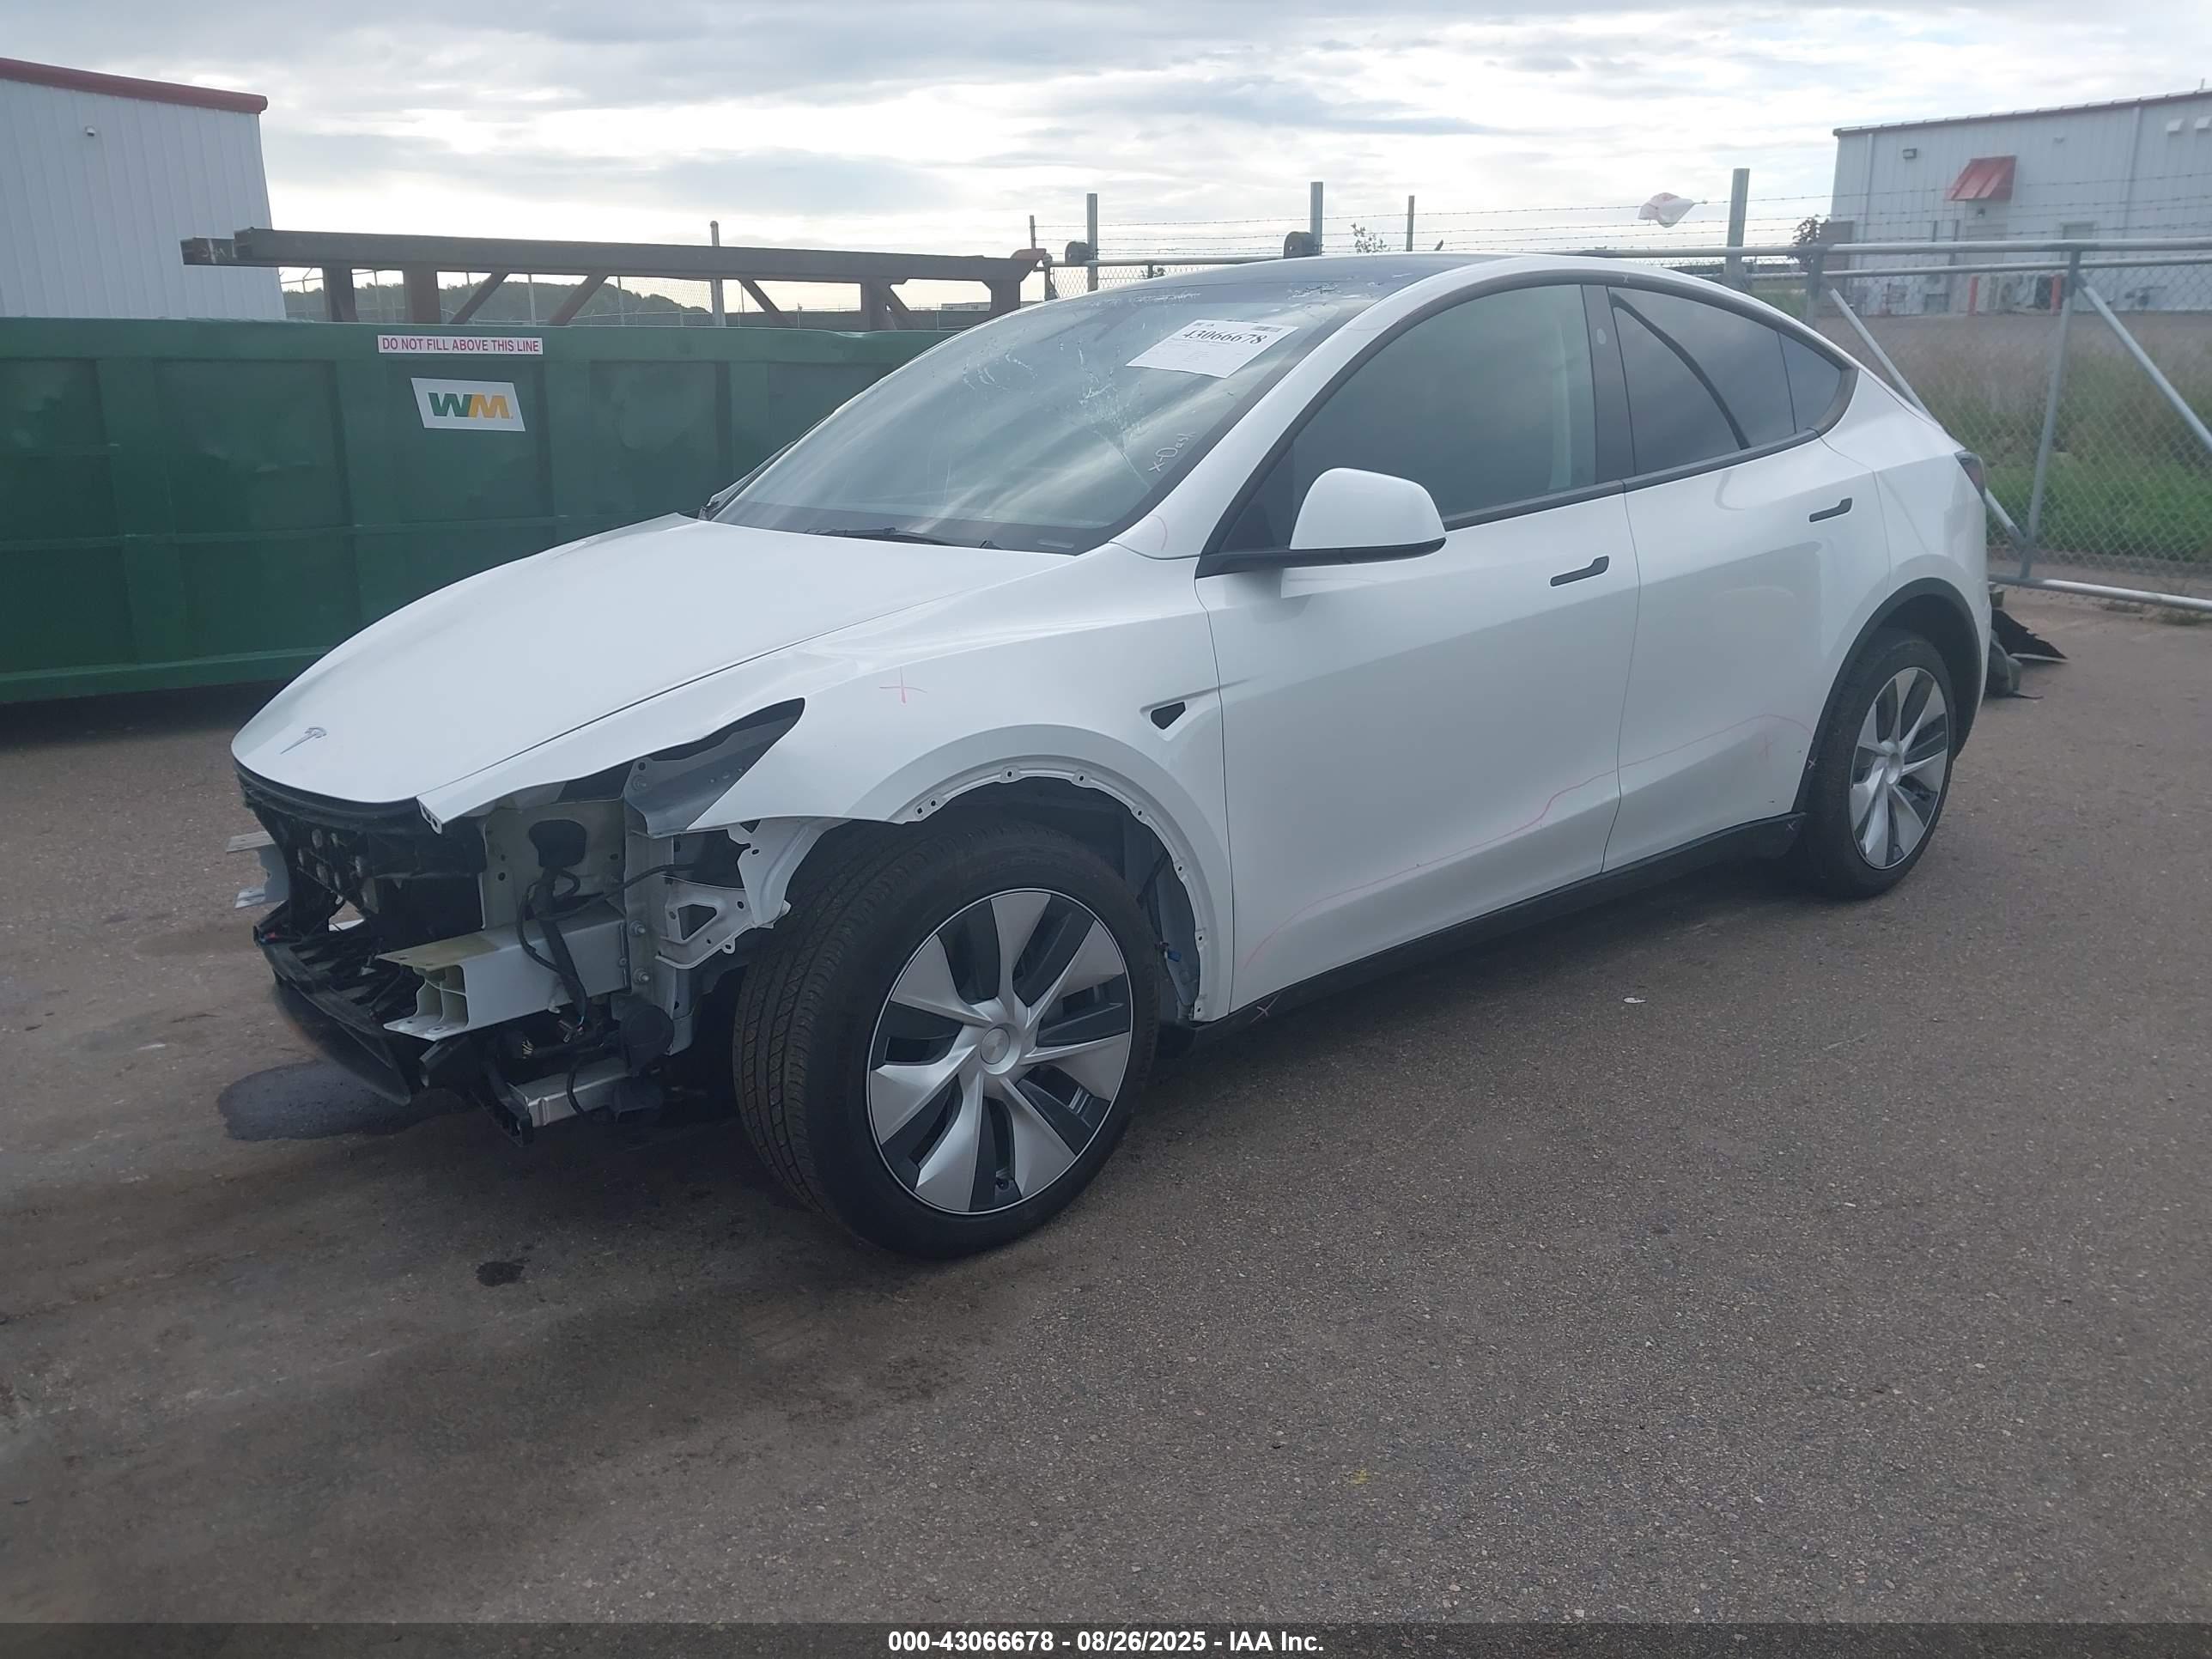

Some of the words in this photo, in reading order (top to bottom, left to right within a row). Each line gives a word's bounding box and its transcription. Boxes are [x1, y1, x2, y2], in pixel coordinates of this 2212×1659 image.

[1182, 329, 1267, 344] 43066678
[382, 337, 398, 350] DO
[401, 338, 423, 350] NOT
[427, 338, 449, 350] FILL
[452, 339, 489, 351] ABOVE
[490, 339, 514, 352] THIS
[516, 340, 539, 352] LINE
[428, 392, 510, 419] WM
